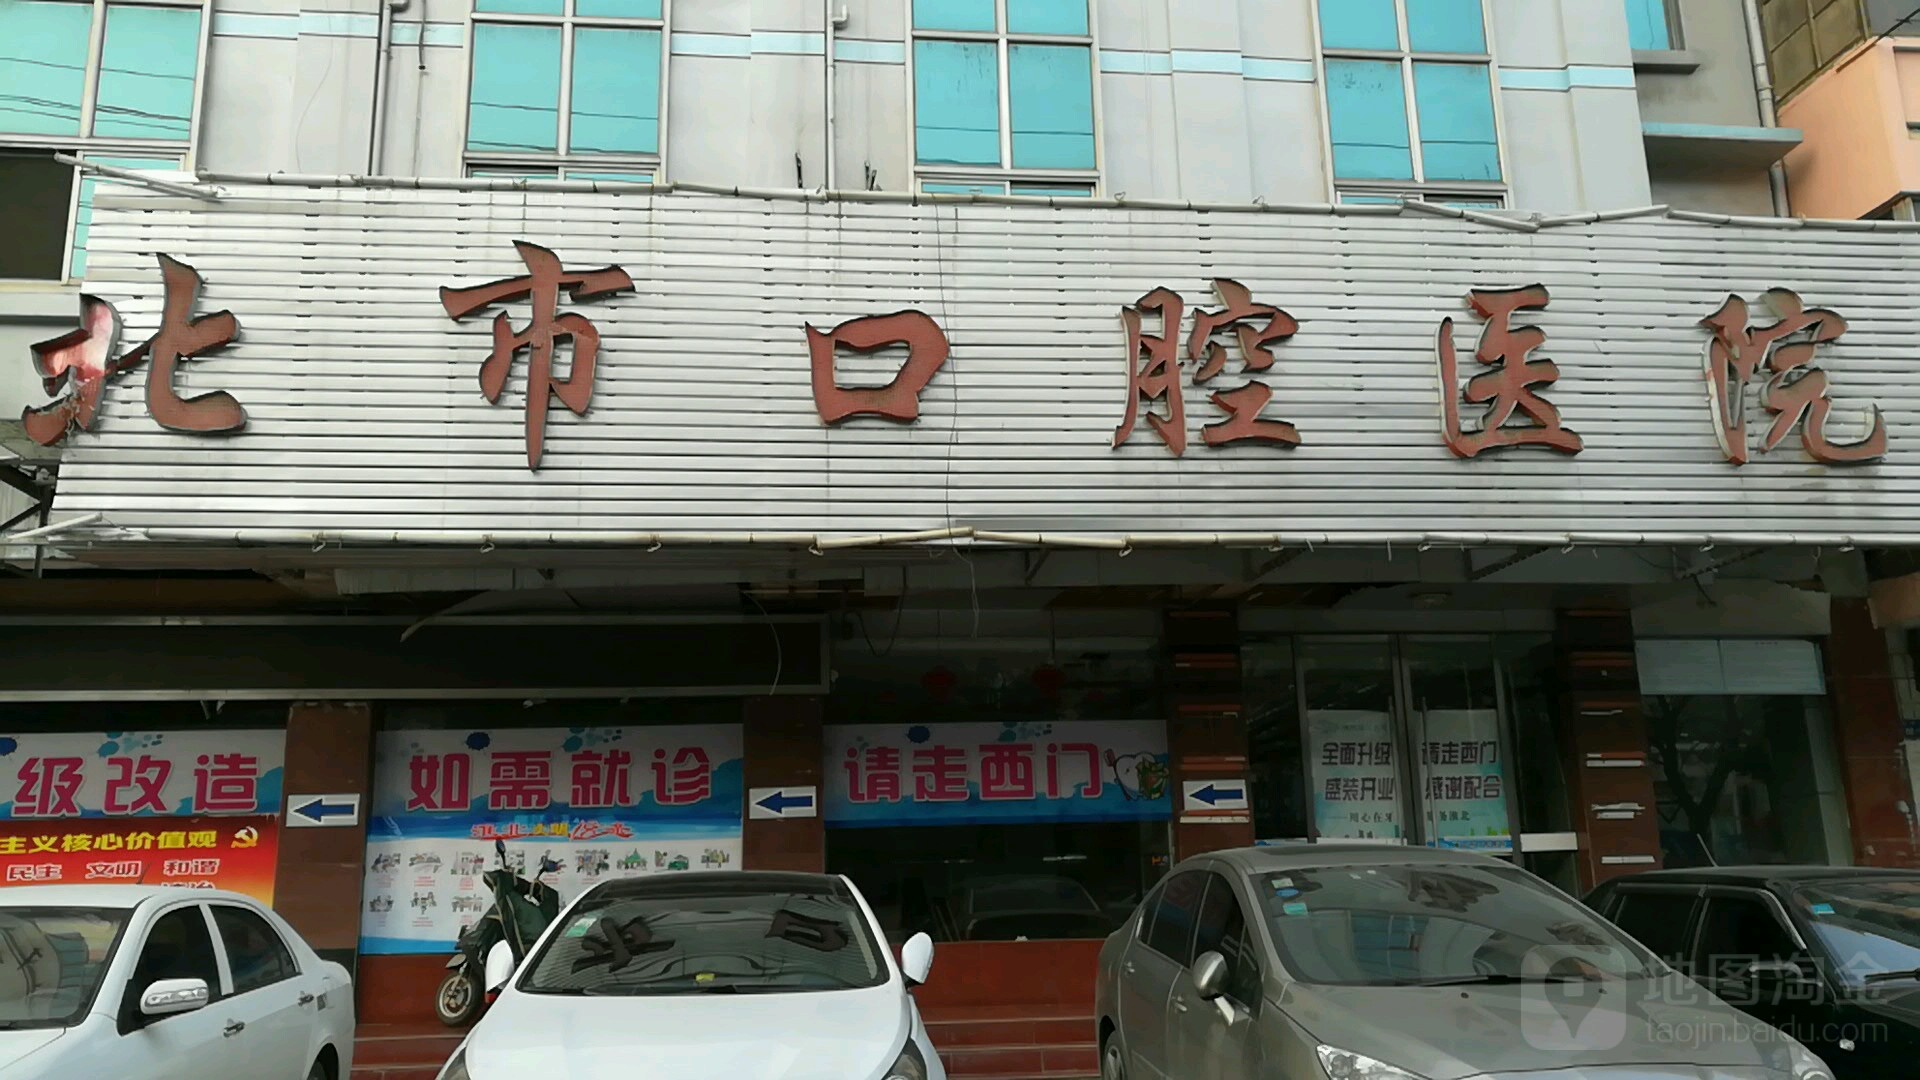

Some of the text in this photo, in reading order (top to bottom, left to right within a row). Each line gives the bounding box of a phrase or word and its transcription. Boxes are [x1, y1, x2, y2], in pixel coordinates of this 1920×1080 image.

[24, 240, 1887, 472] 北市口腔医院
[1322, 742, 1392, 765] 全面升级
[1421, 741, 1497, 765] 请走西门
[12, 753, 260, 817] 级改造
[406, 746, 711, 812] 如需就诊
[844, 743, 1104, 803] 请走西门
[1325, 777, 1394, 800] 盛装开业
[1424, 775, 1501, 800] 感谢配合
[0, 830, 217, 855] 主义核心价值观
[7, 859, 220, 881] 民主 文明 和谐
